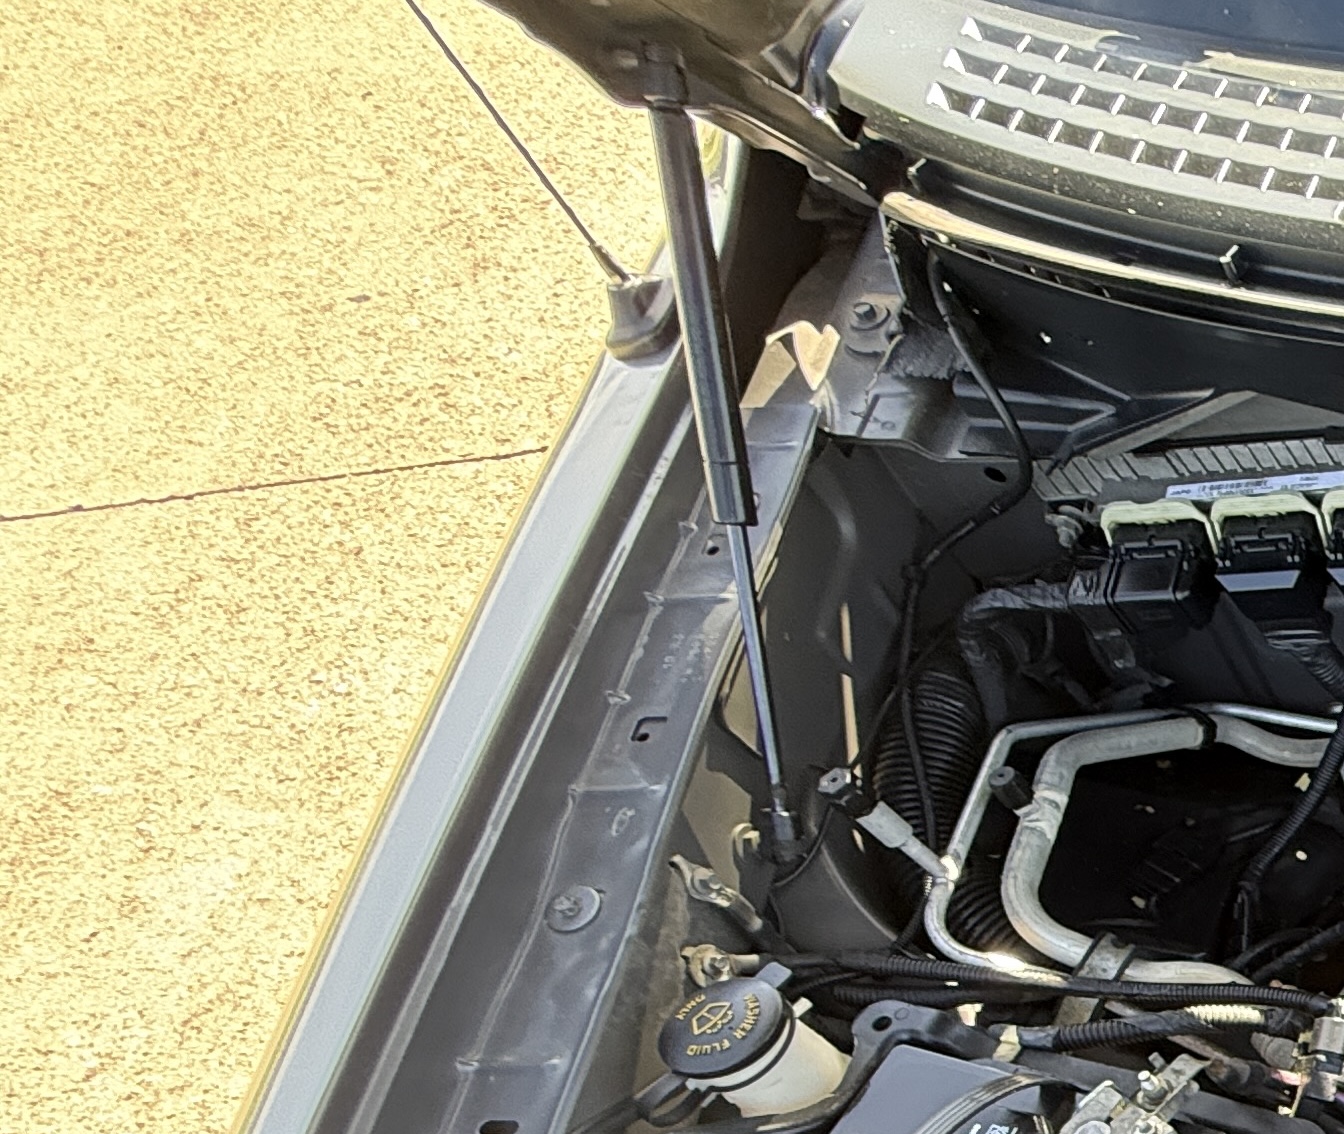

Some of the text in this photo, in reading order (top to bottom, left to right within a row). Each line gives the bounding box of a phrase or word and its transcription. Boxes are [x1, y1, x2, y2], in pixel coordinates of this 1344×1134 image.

[674, 993, 706, 1020] ONLY
[685, 992, 760, 1056] WASHER FLUID
